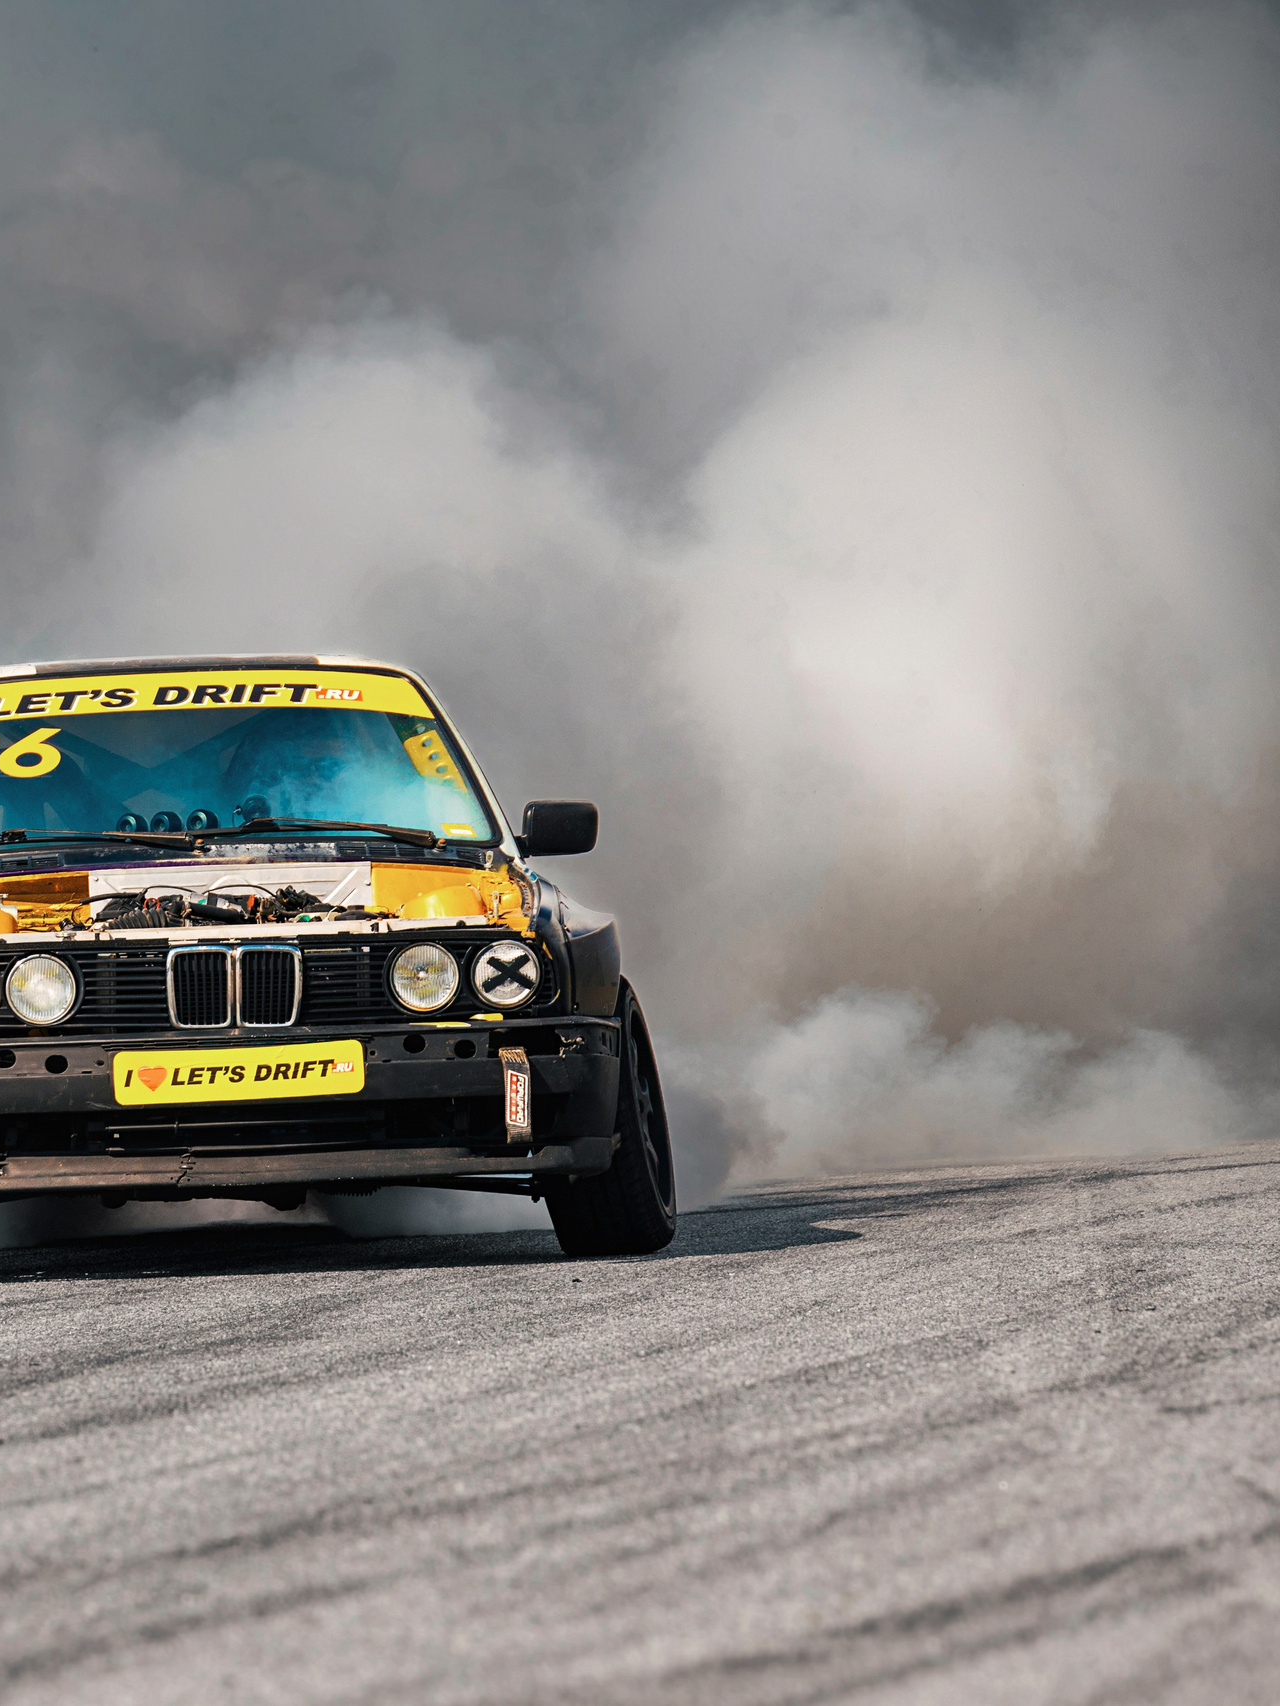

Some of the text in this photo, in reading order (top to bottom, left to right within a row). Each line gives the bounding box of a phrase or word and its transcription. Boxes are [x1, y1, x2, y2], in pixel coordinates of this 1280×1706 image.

[124, 1069, 134, 1088] I
[170, 1064, 246, 1086] LET'S
[516, 1075, 525, 1123] FORWARD
